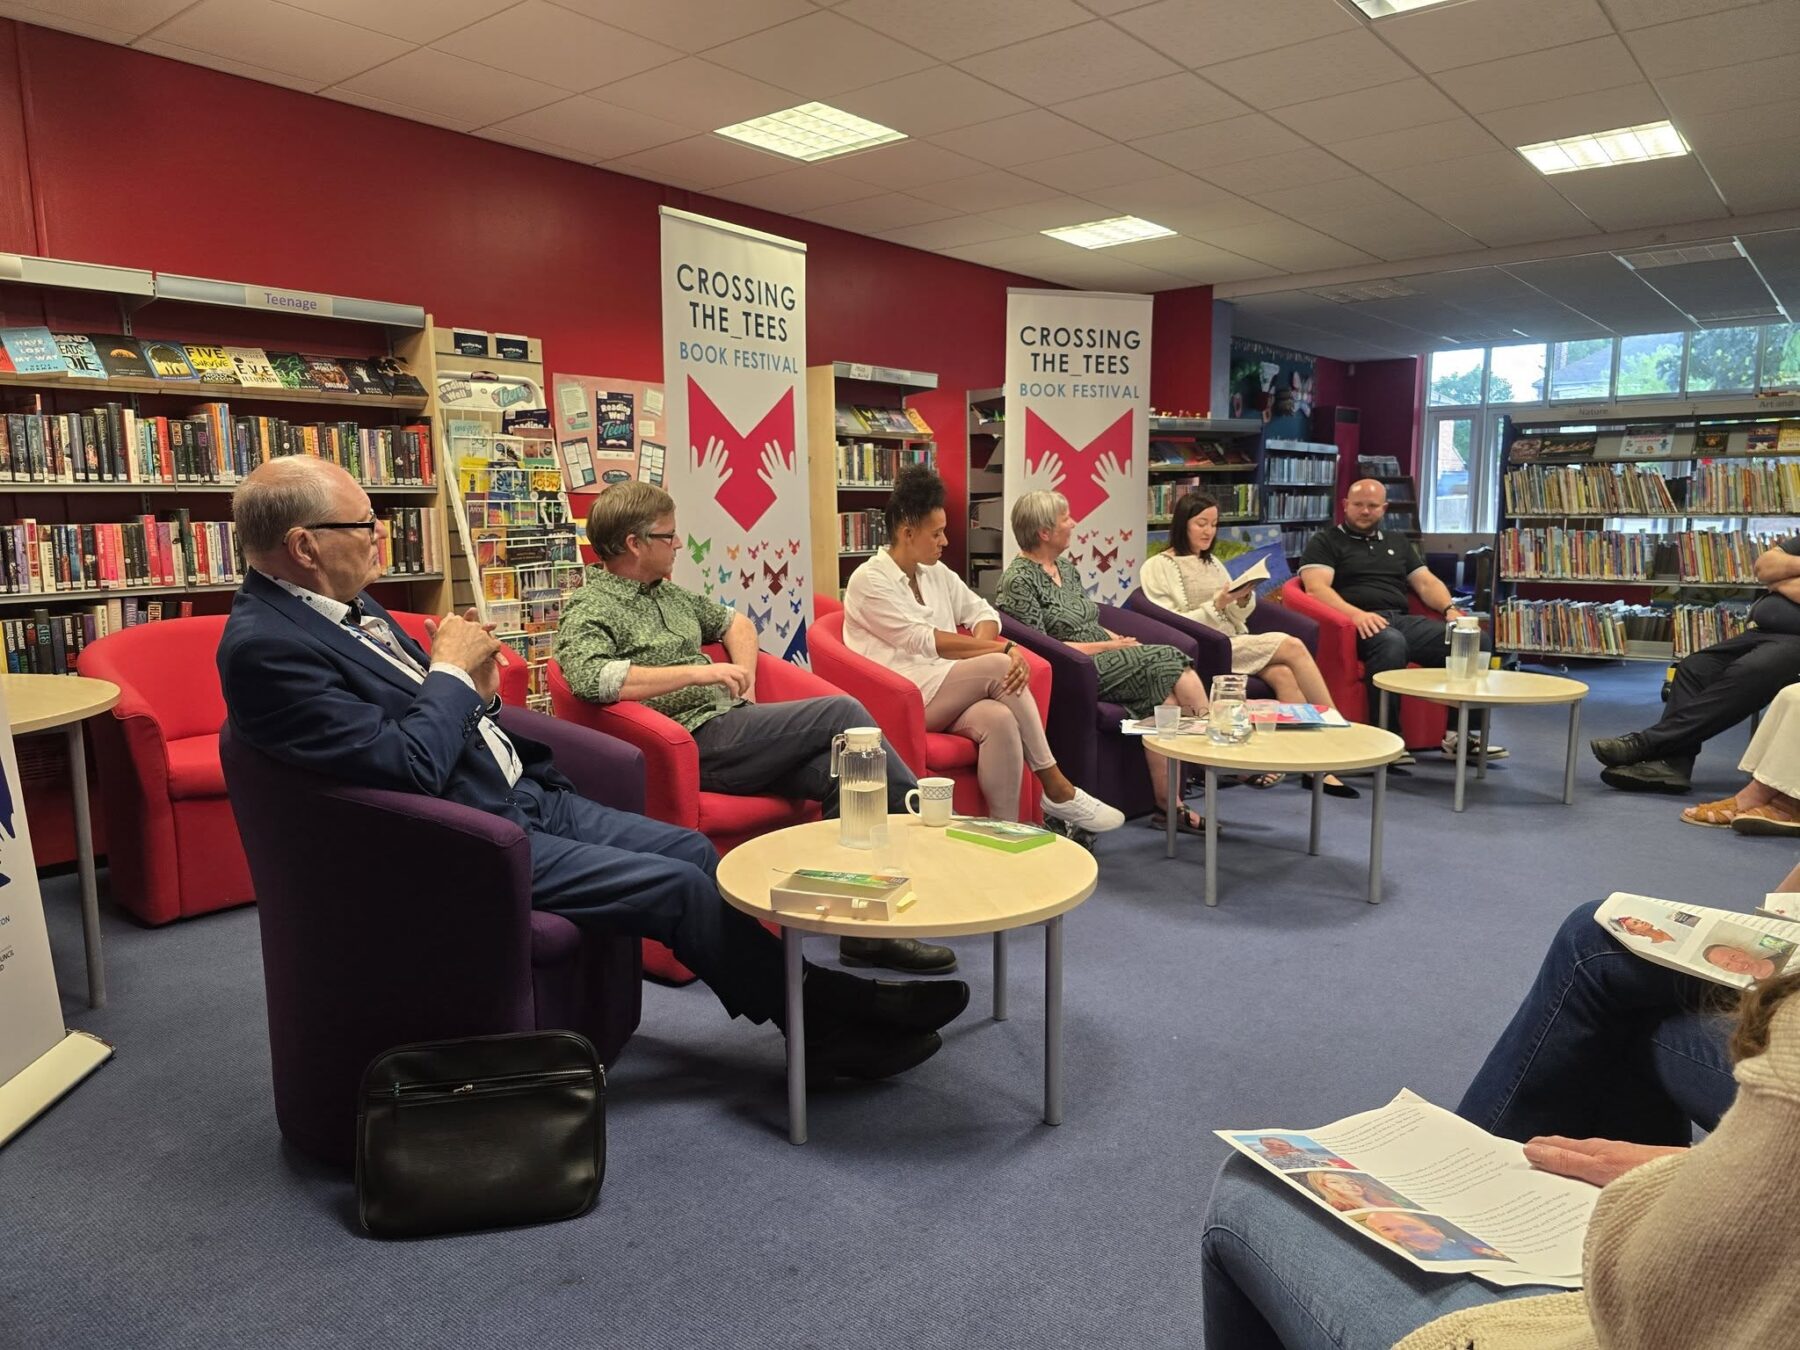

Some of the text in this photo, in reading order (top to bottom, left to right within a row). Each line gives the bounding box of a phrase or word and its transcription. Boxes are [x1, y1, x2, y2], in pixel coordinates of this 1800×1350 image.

[677, 263, 796, 311] CROSSING
[264, 292, 317, 311] Teenage
[1019, 326, 1141, 350] CROSSING
[59, 344, 84, 355] EADS
[184, 347, 226, 359] FIVE
[679, 342, 798, 375] BOOK FESTIVAL
[235, 363, 273, 376] EVE
[1019, 383, 1140, 399] BOOK FESTIVAL
[1579, 407, 1609, 416] Nature
